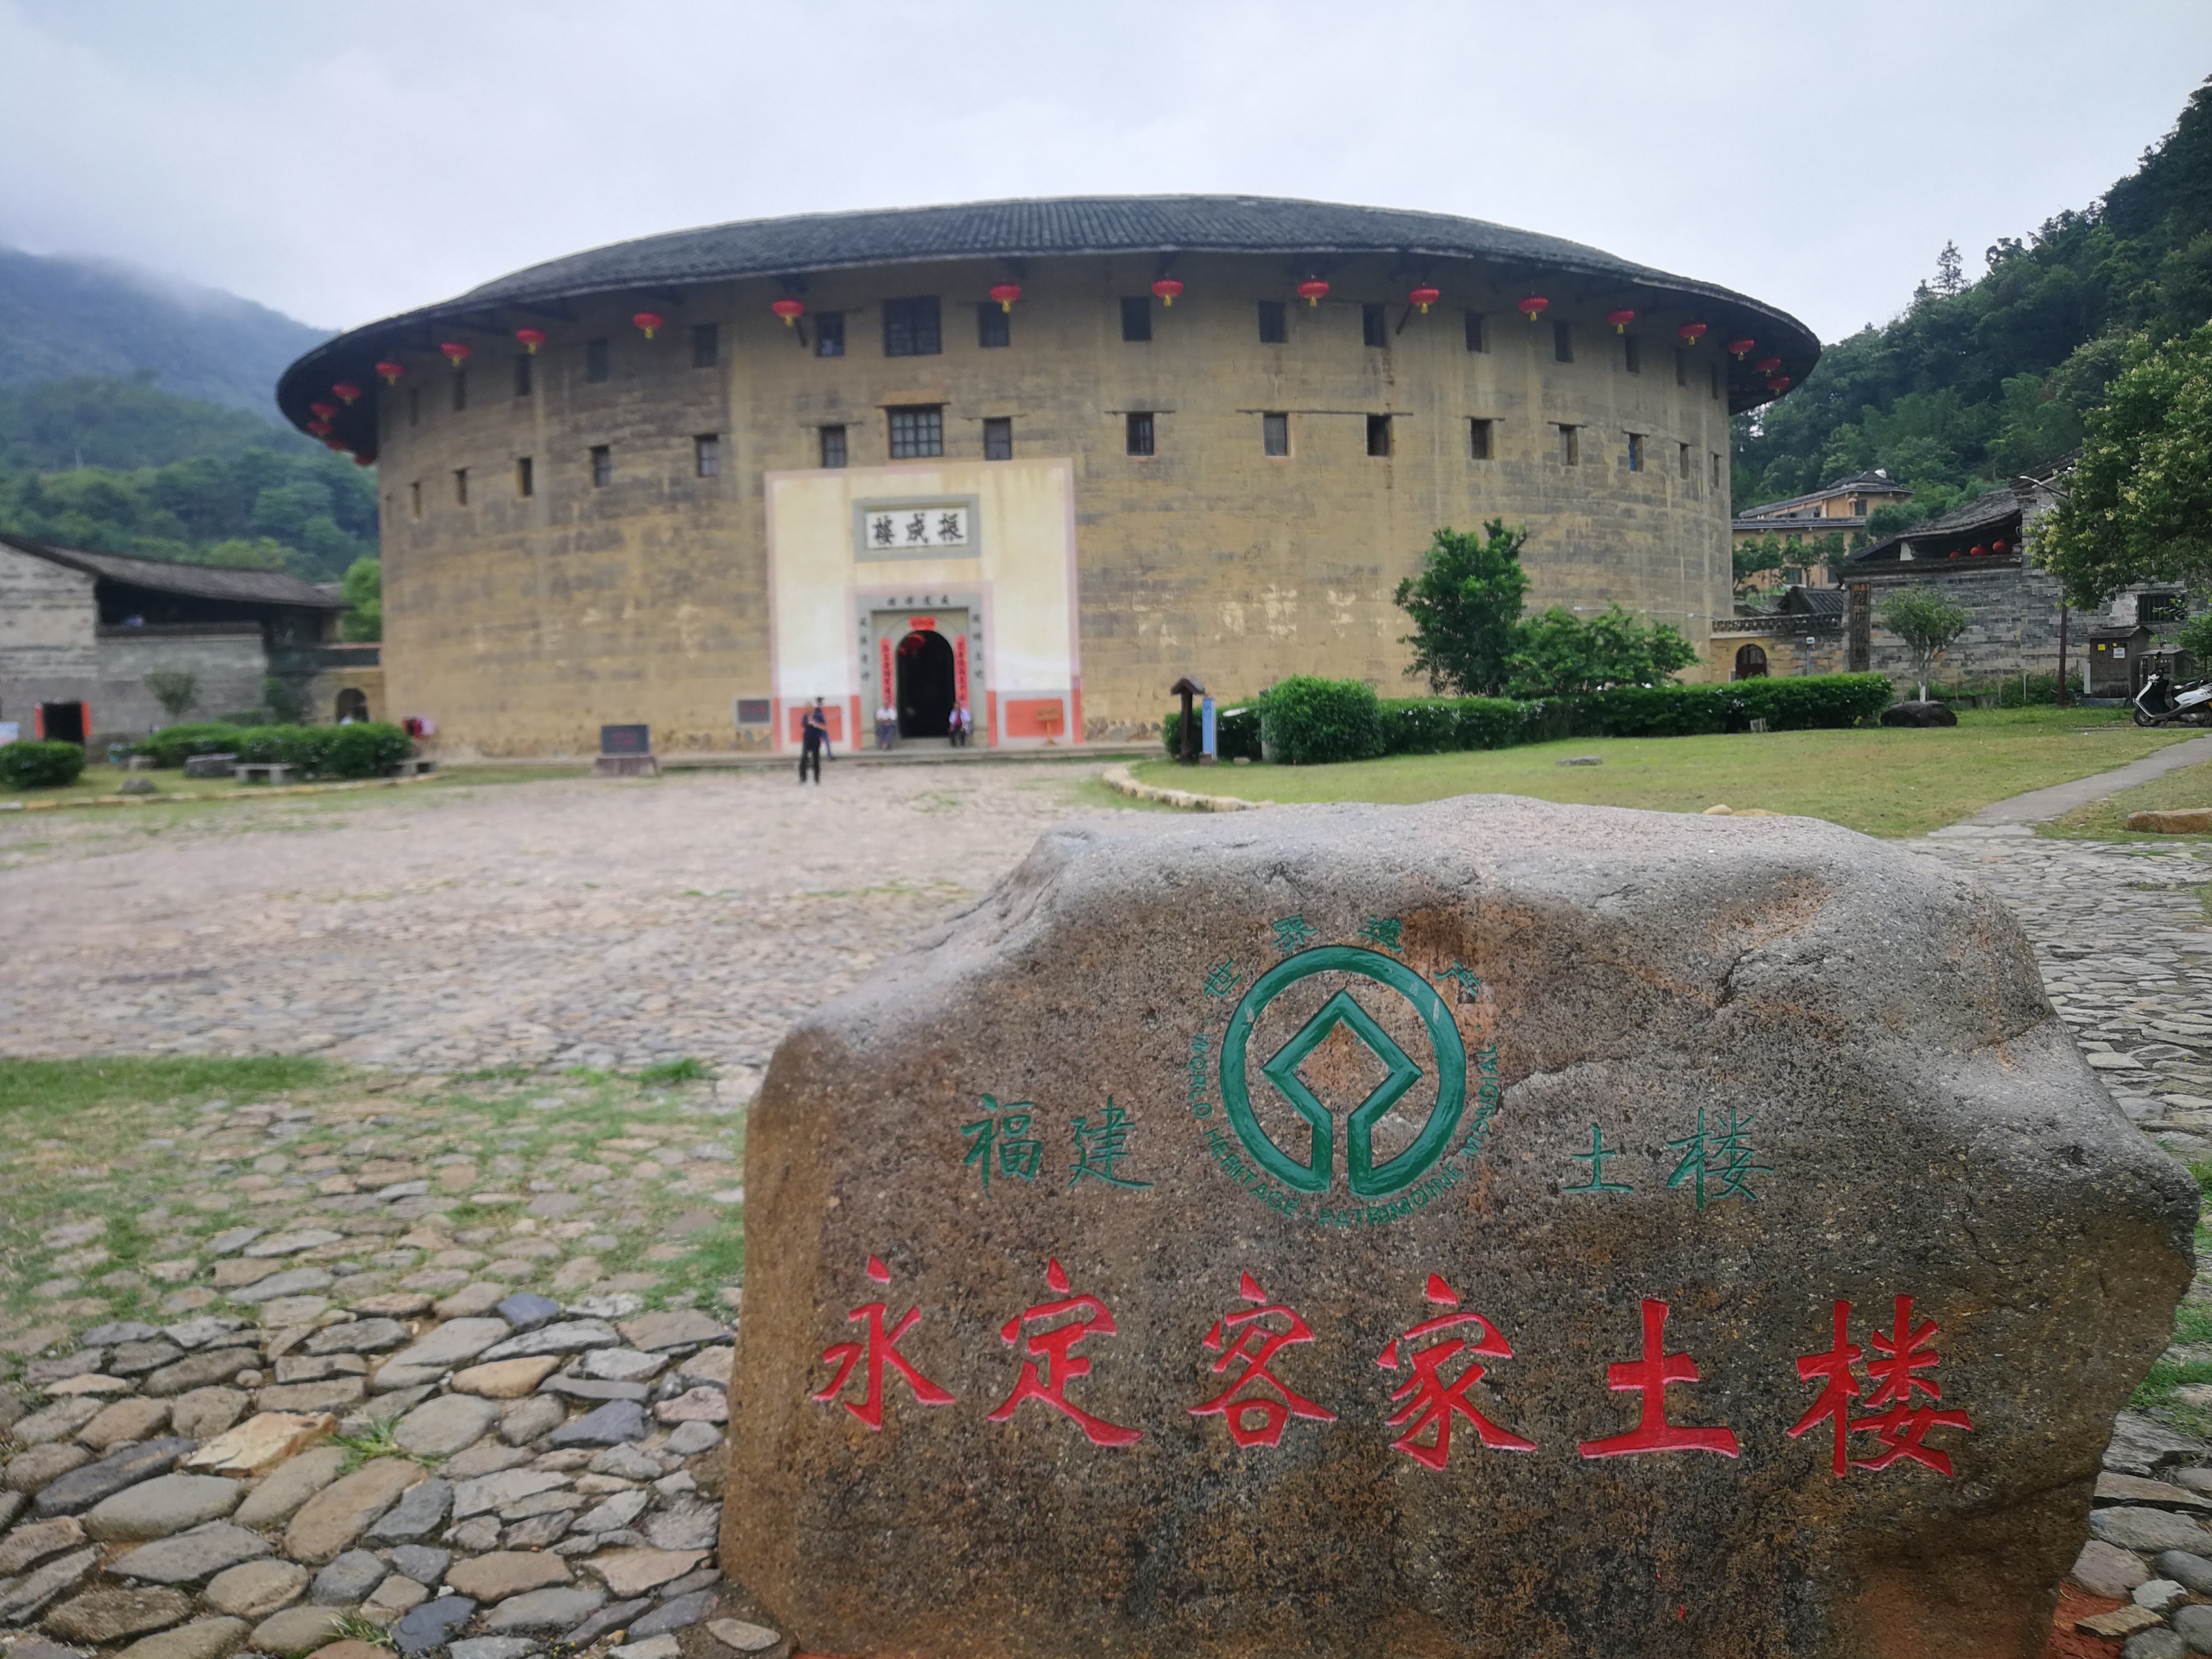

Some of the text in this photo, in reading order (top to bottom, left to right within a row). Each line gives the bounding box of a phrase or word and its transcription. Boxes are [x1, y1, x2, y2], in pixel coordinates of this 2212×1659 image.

[960, 1093, 1775, 1211] 福建 土楼
[1189, 1034, 1301, 1220] WORLD HERITAGE
[1319, 1043, 1500, 1228] PATRIMOINE MONDIAL
[812, 1255, 1974, 1477] 永定客家土楼
